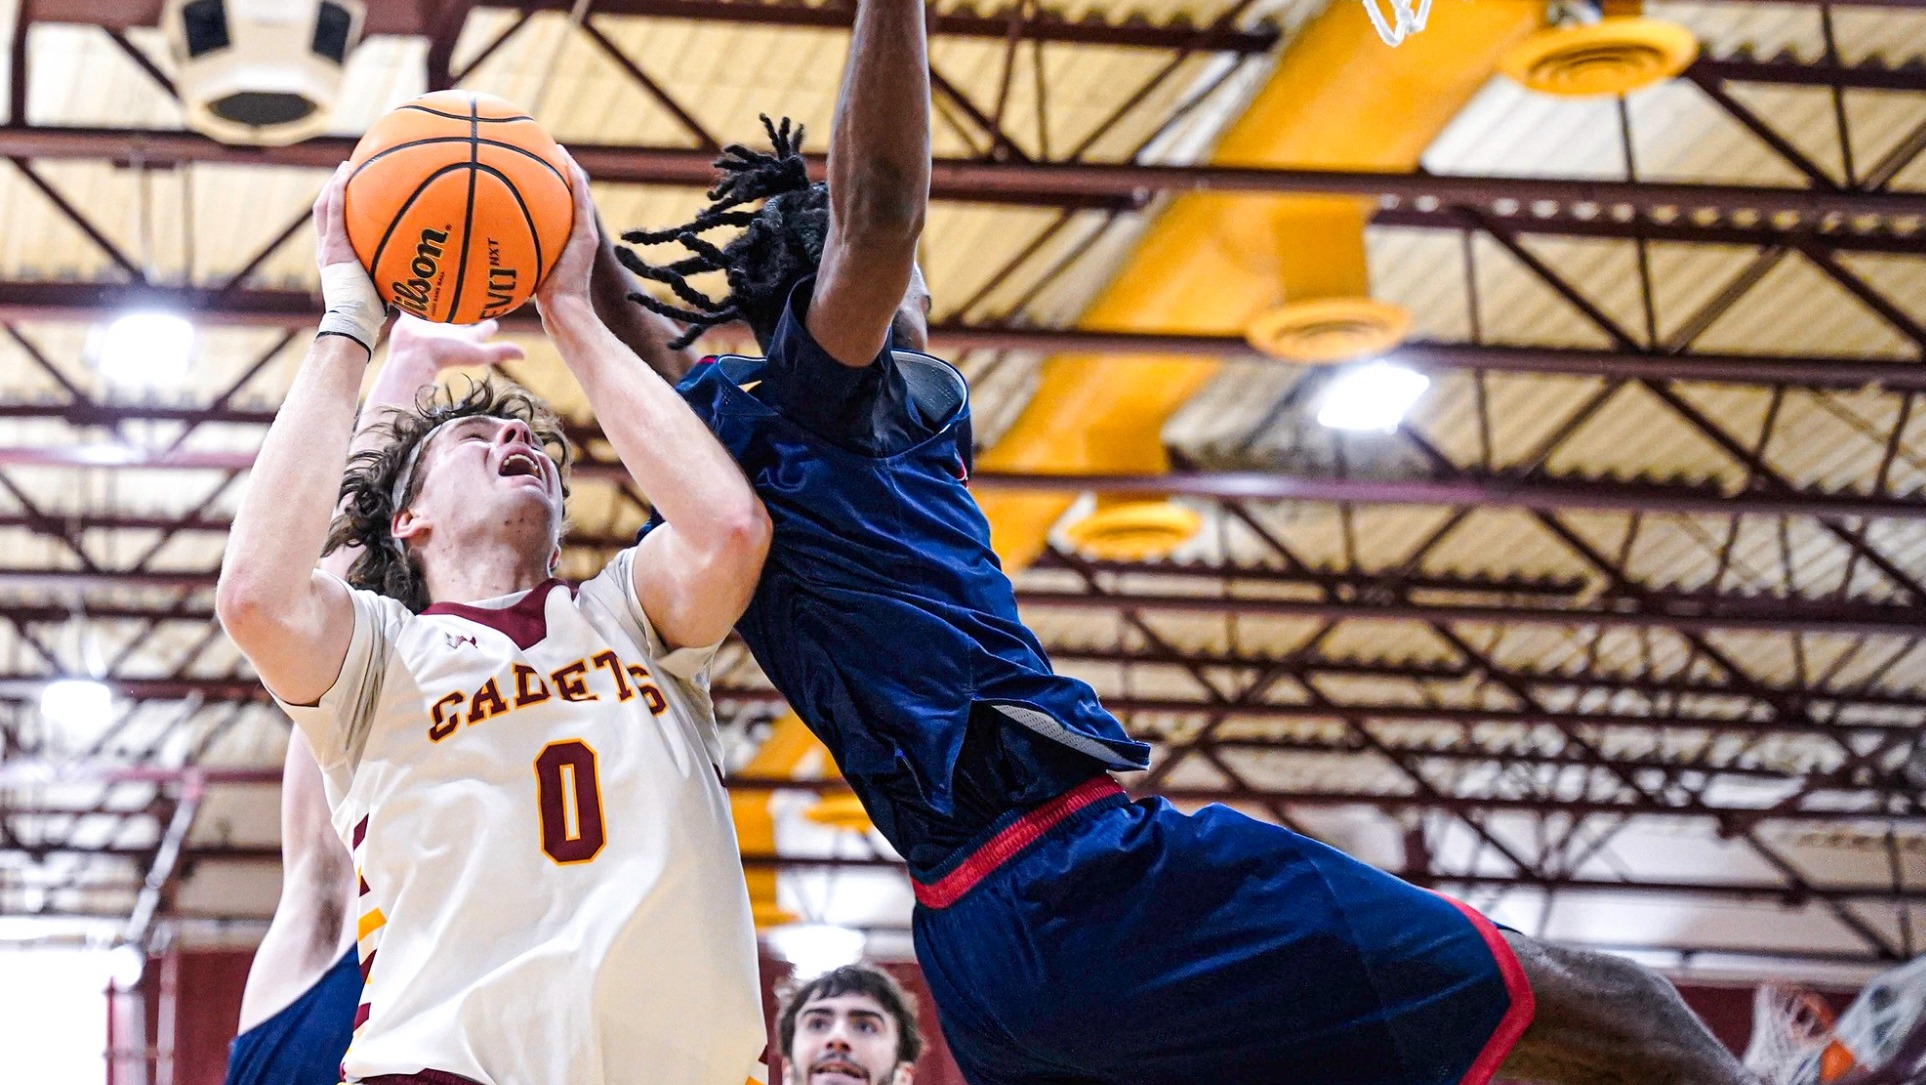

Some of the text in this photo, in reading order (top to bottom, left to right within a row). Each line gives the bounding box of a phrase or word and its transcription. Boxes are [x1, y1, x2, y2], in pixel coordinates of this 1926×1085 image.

[487, 237, 499, 268] NXT
[428, 649, 668, 743] CADETS
[533, 738, 607, 866] 0
